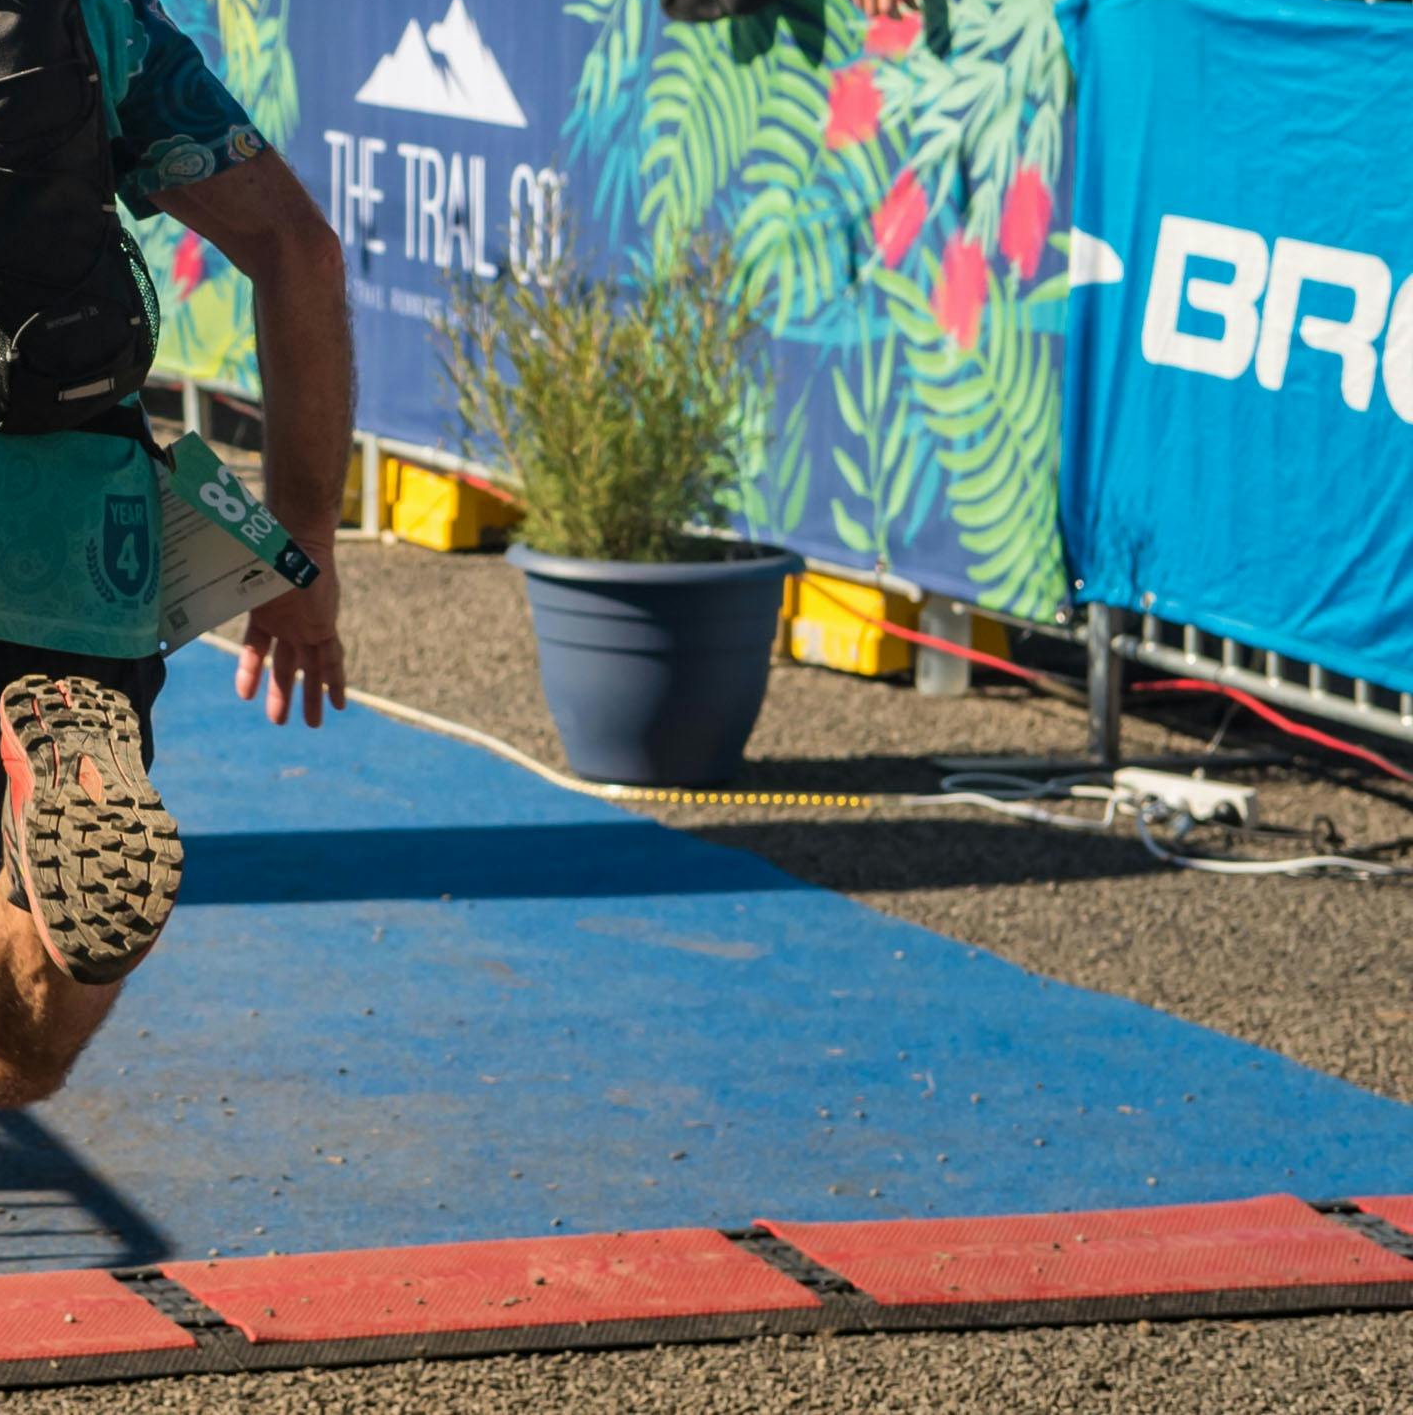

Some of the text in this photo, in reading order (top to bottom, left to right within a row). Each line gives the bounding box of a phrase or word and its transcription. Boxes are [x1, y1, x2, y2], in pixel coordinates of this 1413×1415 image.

[323, 130, 562, 287] THE TRAIL CO
[1141, 214, 1413, 427] BR
[110, 502, 145, 525] YEAR
[116, 532, 141, 581] 4
